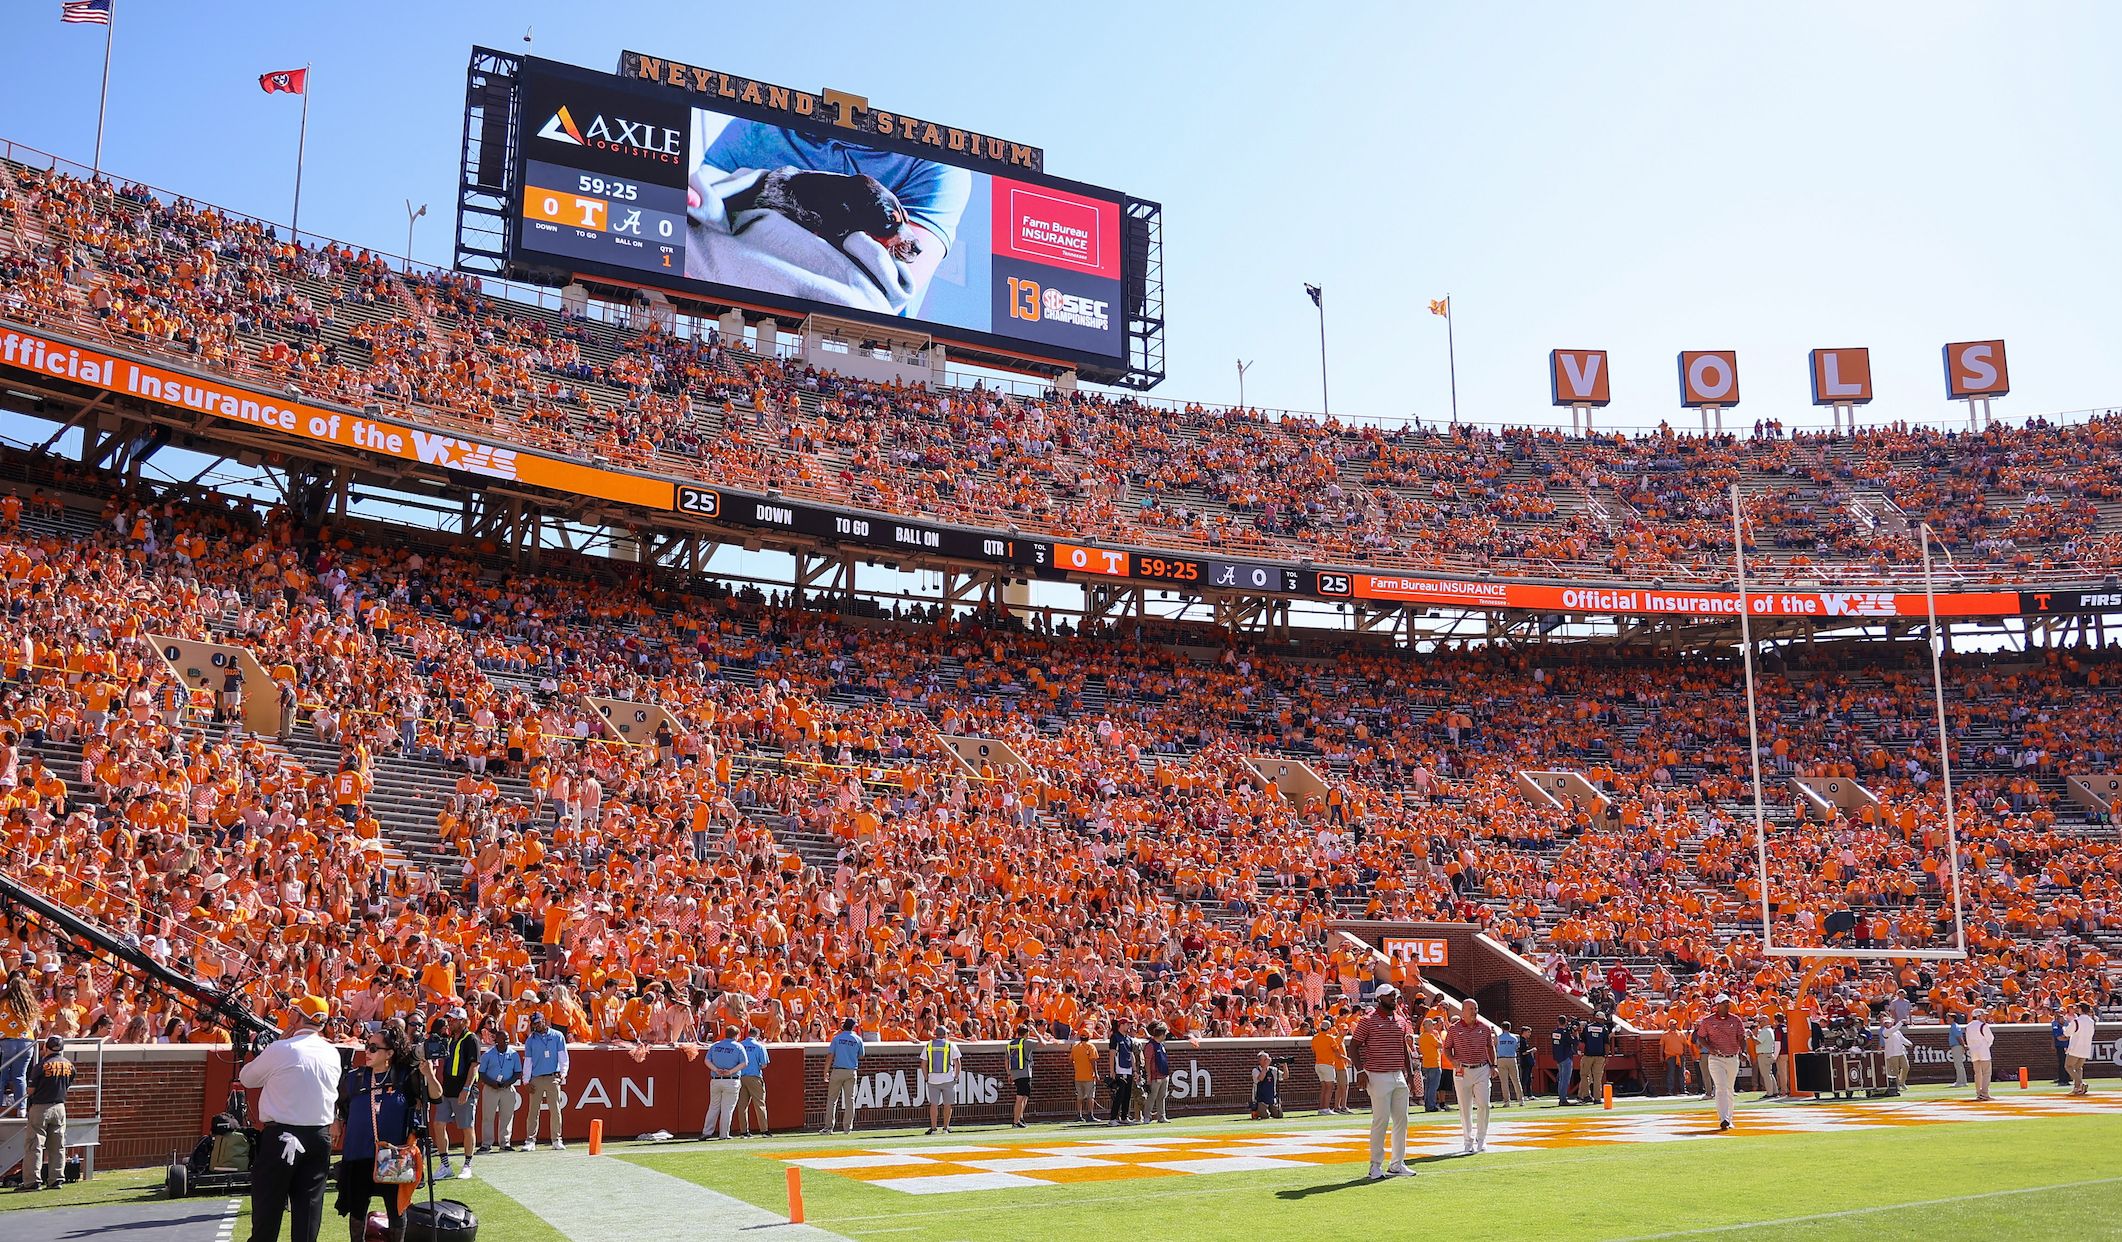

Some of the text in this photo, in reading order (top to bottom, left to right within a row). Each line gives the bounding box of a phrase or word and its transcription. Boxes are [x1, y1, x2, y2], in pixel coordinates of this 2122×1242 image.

[638, 55, 815, 117] NEYLAND
[877, 110, 1033, 168] STADIUM
[586, 114, 681, 156] AXLE
[586, 137, 680, 165] LOGISTICS
[578, 174, 639, 201] 59:25
[543, 197, 560, 216] 0
[575, 198, 604, 227] T
[657, 219, 674, 238] 0
[535, 222, 558, 233] DOWN
[575, 229, 597, 240] TO GO
[1022, 215, 1089, 239] Farm Bureau
[614, 237, 644, 248] BALL ON
[1021, 227, 1088, 251] INSURANCE
[659, 245, 675, 254] QTR
[1062, 249, 1088, 261] Tennessee
[661, 254, 673, 268] 1
[1006, 276, 1041, 322] 13
[1062, 294, 1109, 320] SEC
[1043, 307, 1109, 331] CHAMPIONSHIPS
[0, 332, 115, 387] fficial
[127, 365, 297, 431] Insurance
[308, 414, 341, 440] of
[351, 420, 404, 454] the
[683, 491, 715, 512] 25
[756, 504, 793, 525] DOWN
[835, 516, 869, 537] TO GO
[895, 526, 940, 548] BALL ON
[983, 539, 1014, 558] QTR 1
[1033, 543, 1047, 551] TOL
[1035, 552, 1045, 564] 3
[1071, 549, 1123, 574] 0 T
[1140, 557, 1199, 580] 59:25
[1251, 568, 1268, 587] 0
[1288, 579, 1297, 590] 3
[1322, 575, 1348, 593] 25
[1370, 577, 1507, 596] Farm Bureau INSURANCE
[1478, 598, 1507, 606] Tennessee
[1562, 589, 1638, 610] Official
[1644, 592, 1742, 613] Insurance
[1753, 594, 1774, 613] of
[1781, 595, 1817, 613] the
[2033, 593, 2122, 611] T FIRS
[215, 655, 223, 666] J
[636, 711, 645, 722] K
[981, 747, 988, 755] L
[1278, 766, 1287, 776] M
[340, 779, 353, 795] 16
[1558, 779, 1566, 788] N
[2110, 781, 2117, 790] P
[584, 836, 600, 849] 98
[310, 896, 319, 907] 5
[788, 998, 805, 1016] 16
[516, 1014, 531, 1034] 16
[43, 1060, 74, 1070] EVENT
[44, 1068, 73, 1078] STAFF
